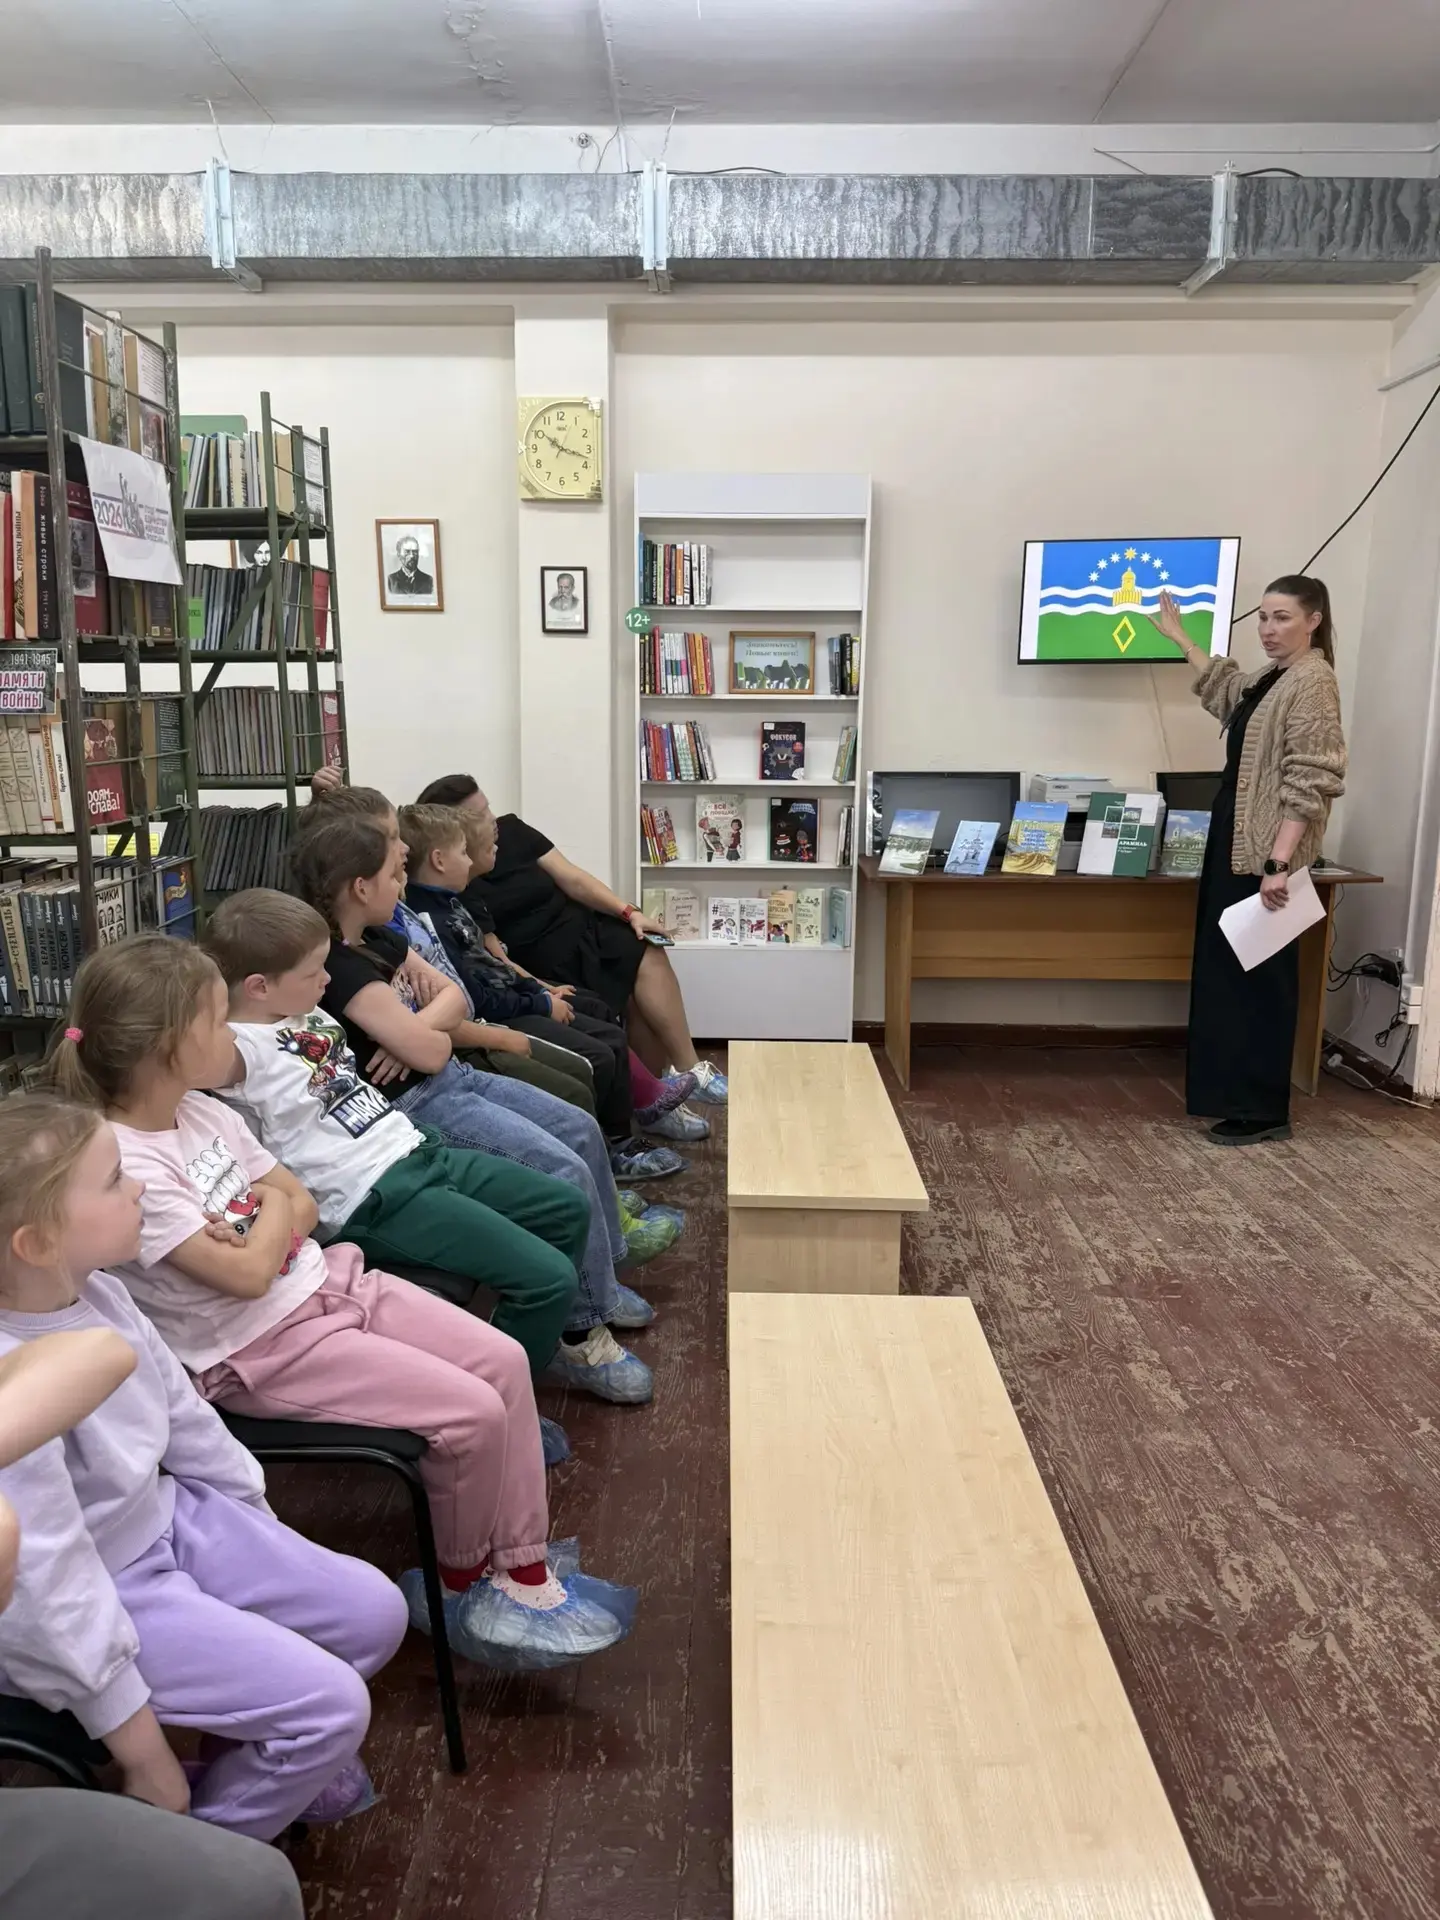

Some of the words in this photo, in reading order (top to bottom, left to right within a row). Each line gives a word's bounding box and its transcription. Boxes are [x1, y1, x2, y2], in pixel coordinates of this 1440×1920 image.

[543, 416, 551, 425] 11
[556, 411, 565, 421] 12
[534, 429, 545, 439] 10
[582, 429, 588, 438] 2
[531, 444, 538, 453] 9
[586, 444, 592, 454] 3
[535, 459, 542, 469] 8
[582, 460, 588, 469] 4
[546, 472, 552, 481] 7
[559, 476, 565, 486] 6
[573, 472, 579, 481] 5
[93, 499, 122, 528] 2026
[625, 613, 651, 628] 12+
[11, 653, 51, 666] 1941-1945
[2, 691, 43, 708] ВОЙНЫ
[87, 788, 115, 808] роям-
[90, 793, 121, 814] слава!
[96, 886, 120, 905] ТЧИКИ
[3, 908, 20, 958] СТЕНДАЛЬ
[37, 927, 49, 966] БЕРАНЖЕ
[333, 1086, 393, 1134] MARVE
